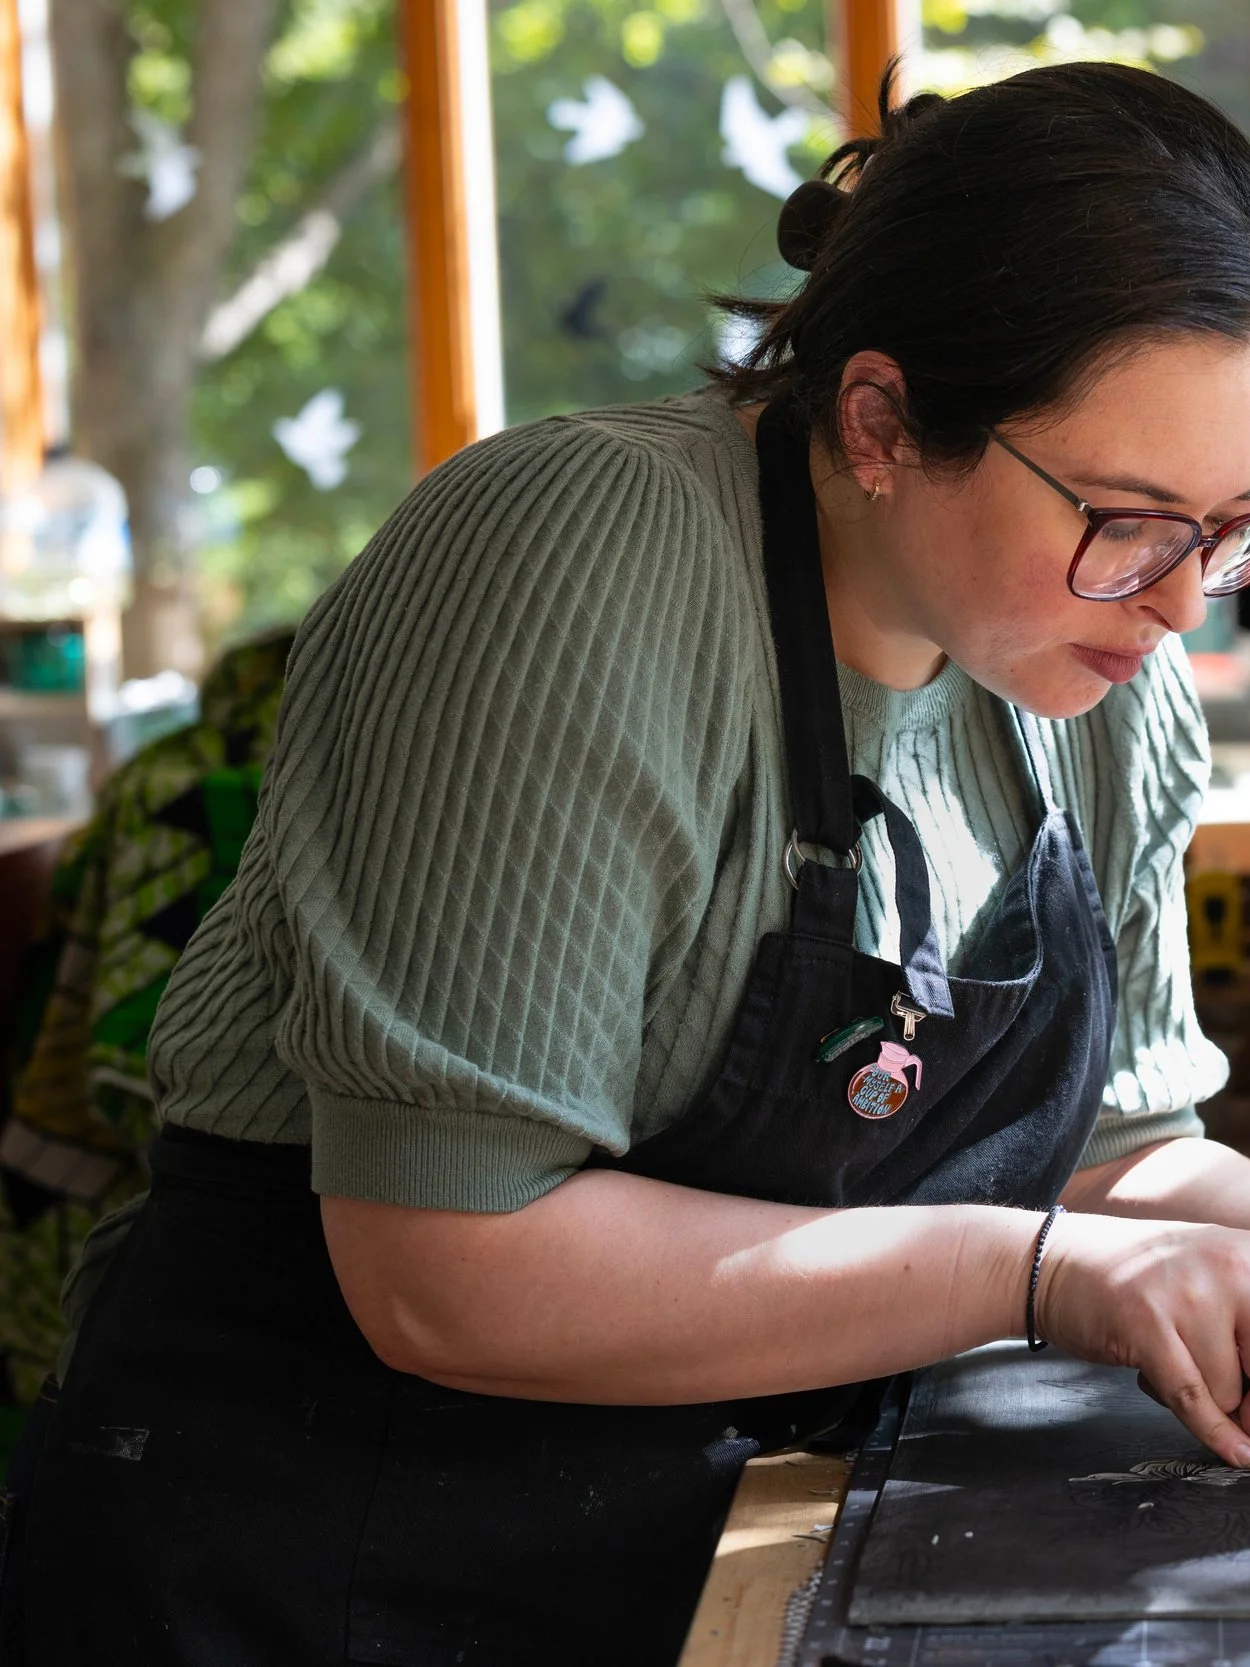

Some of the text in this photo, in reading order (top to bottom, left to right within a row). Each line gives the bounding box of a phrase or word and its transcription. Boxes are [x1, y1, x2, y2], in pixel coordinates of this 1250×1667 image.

[869, 1064, 891, 1081] POUR
[863, 1075, 902, 1093] MYSELF A
[852, 1092, 891, 1114] AMBITION
[860, 1085, 889, 1103] CUP OF
